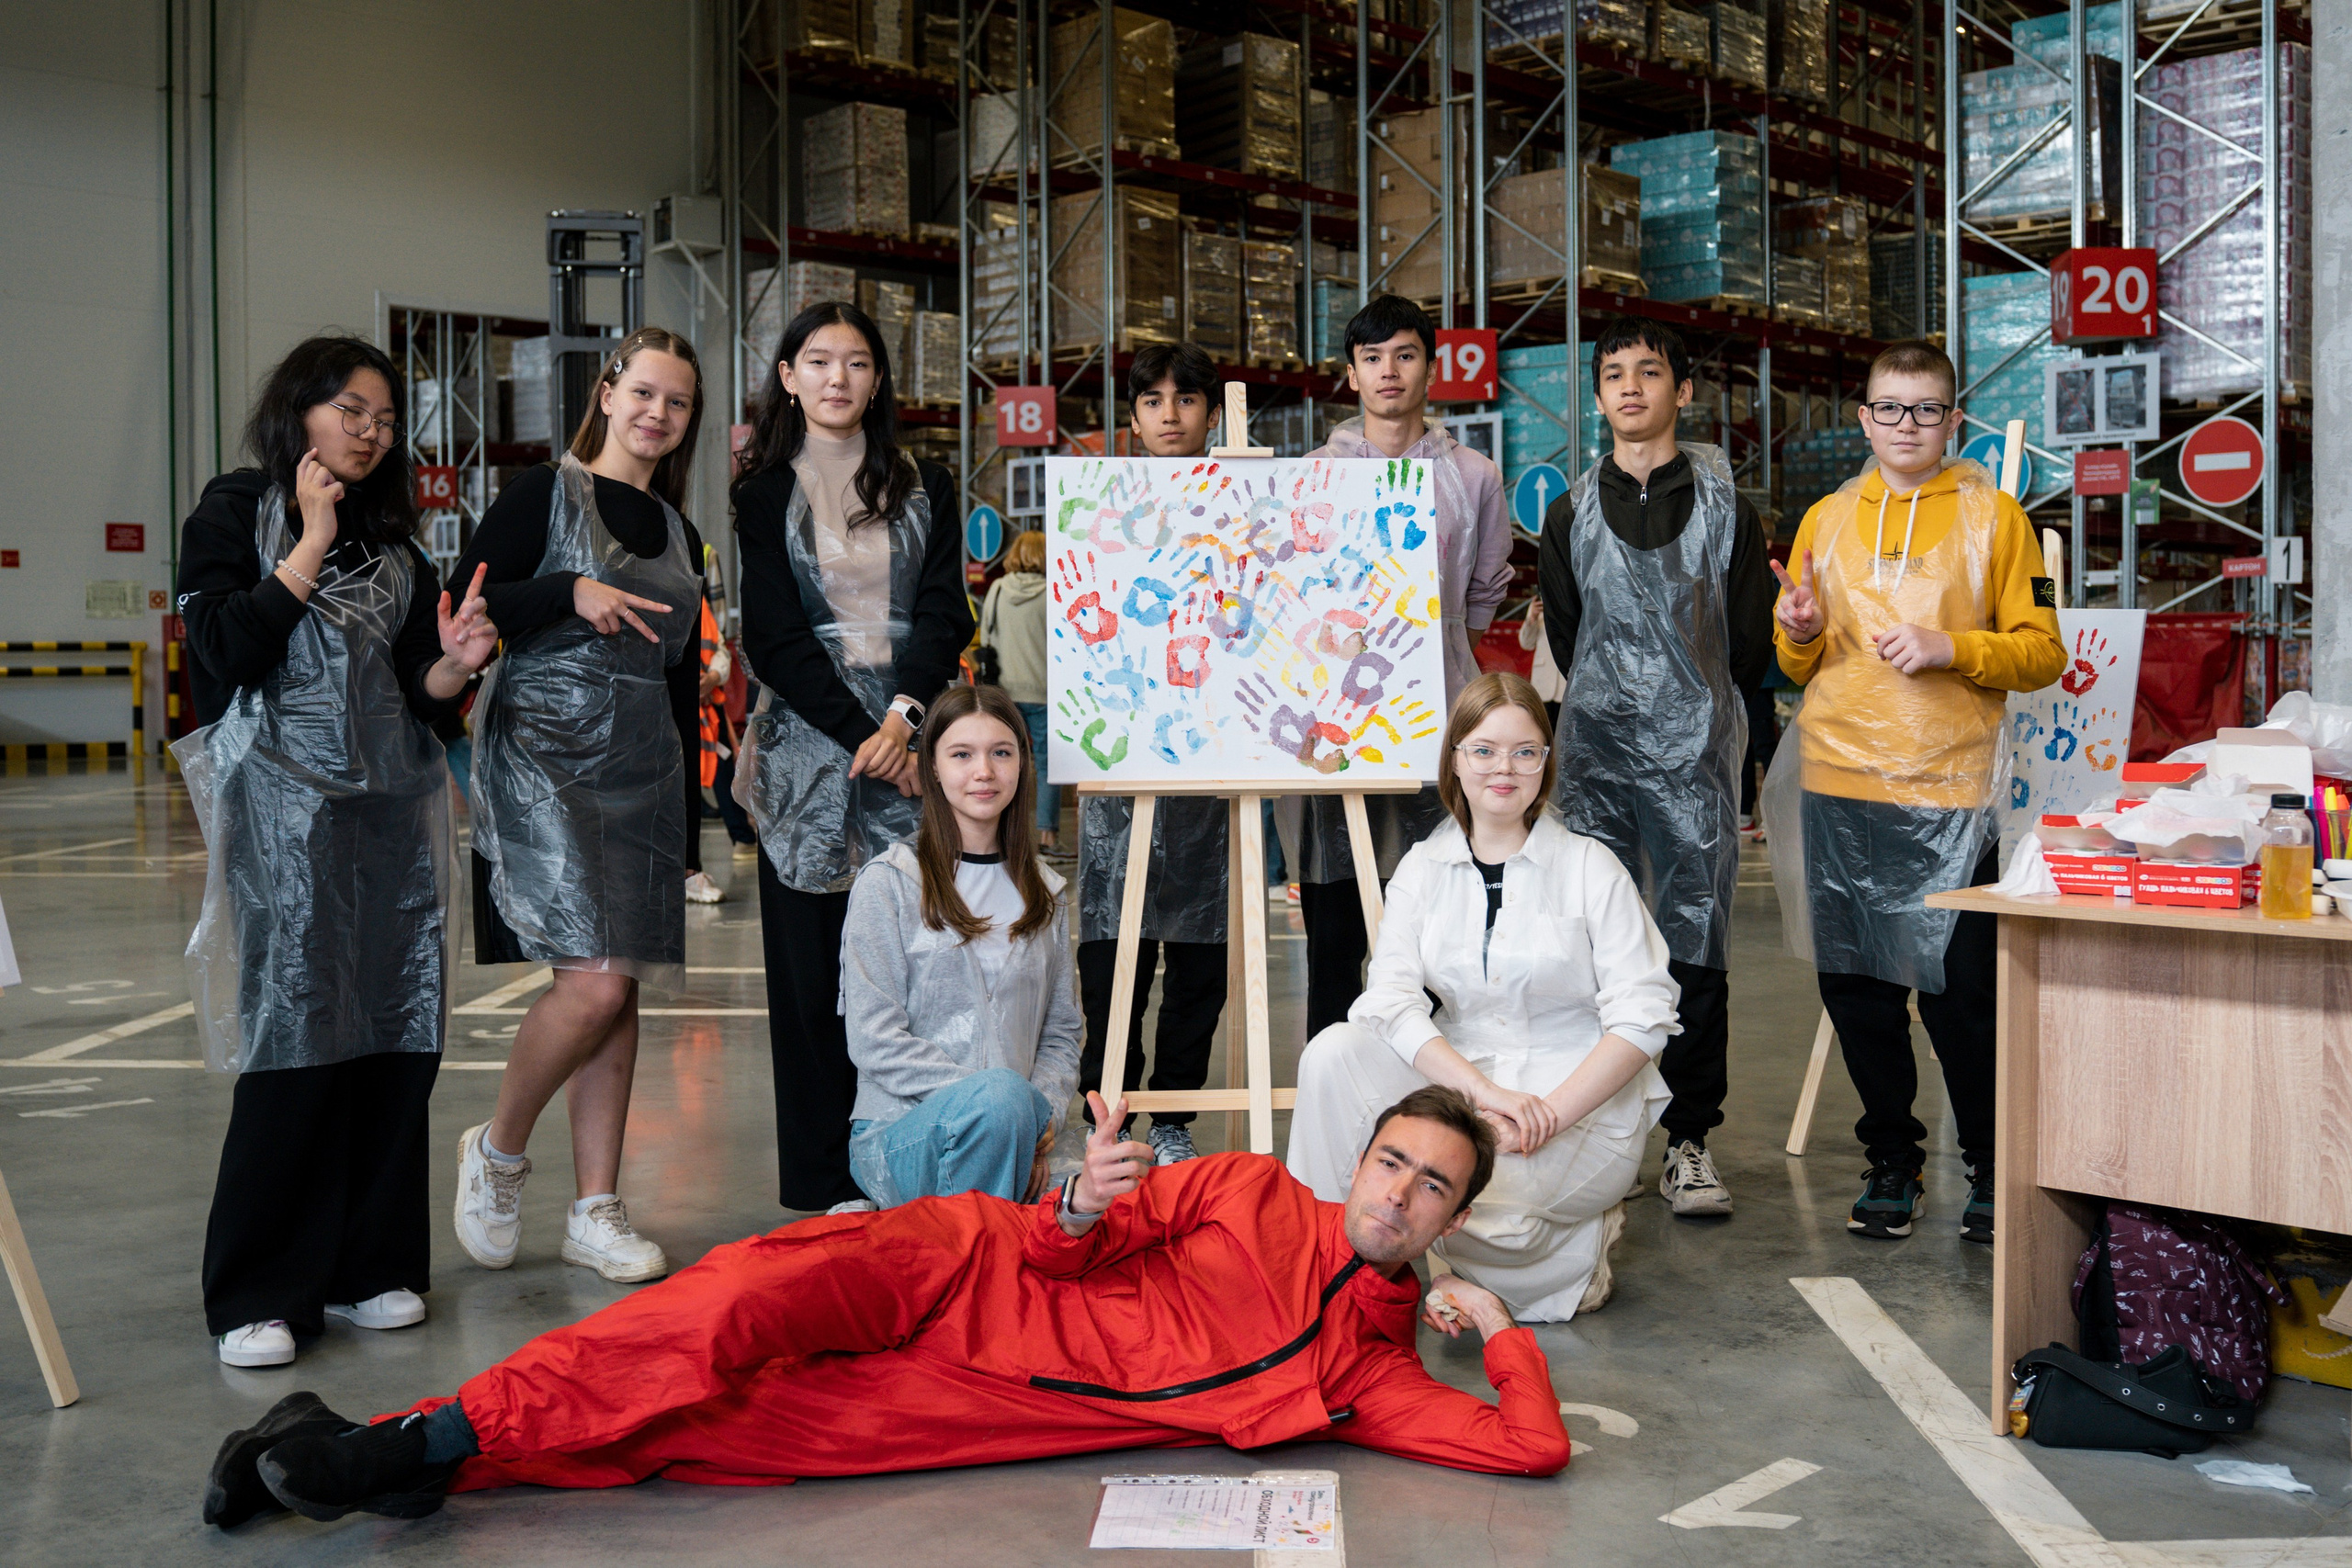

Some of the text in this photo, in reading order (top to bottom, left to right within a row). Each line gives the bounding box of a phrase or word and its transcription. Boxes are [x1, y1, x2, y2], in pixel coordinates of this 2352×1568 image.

[2052, 270, 2069, 321] 19
[2081, 265, 2150, 314] 20
[2142, 313, 2152, 335] 1
[1435, 343, 1486, 382] 19
[1484, 381, 1494, 400] 1
[1000, 400, 1043, 434] 18
[1045, 429, 1055, 445] 1
[419, 473, 451, 498] 16
[448, 496, 456, 507] 1
[2228, 562, 2261, 572] КАРТОН
[2282, 539, 2291, 581] 1
[2138, 884, 2159, 892] ГУАШЬ
[1252, 1489, 1274, 1543] ОБХОДНОЙ ЛИСТ
